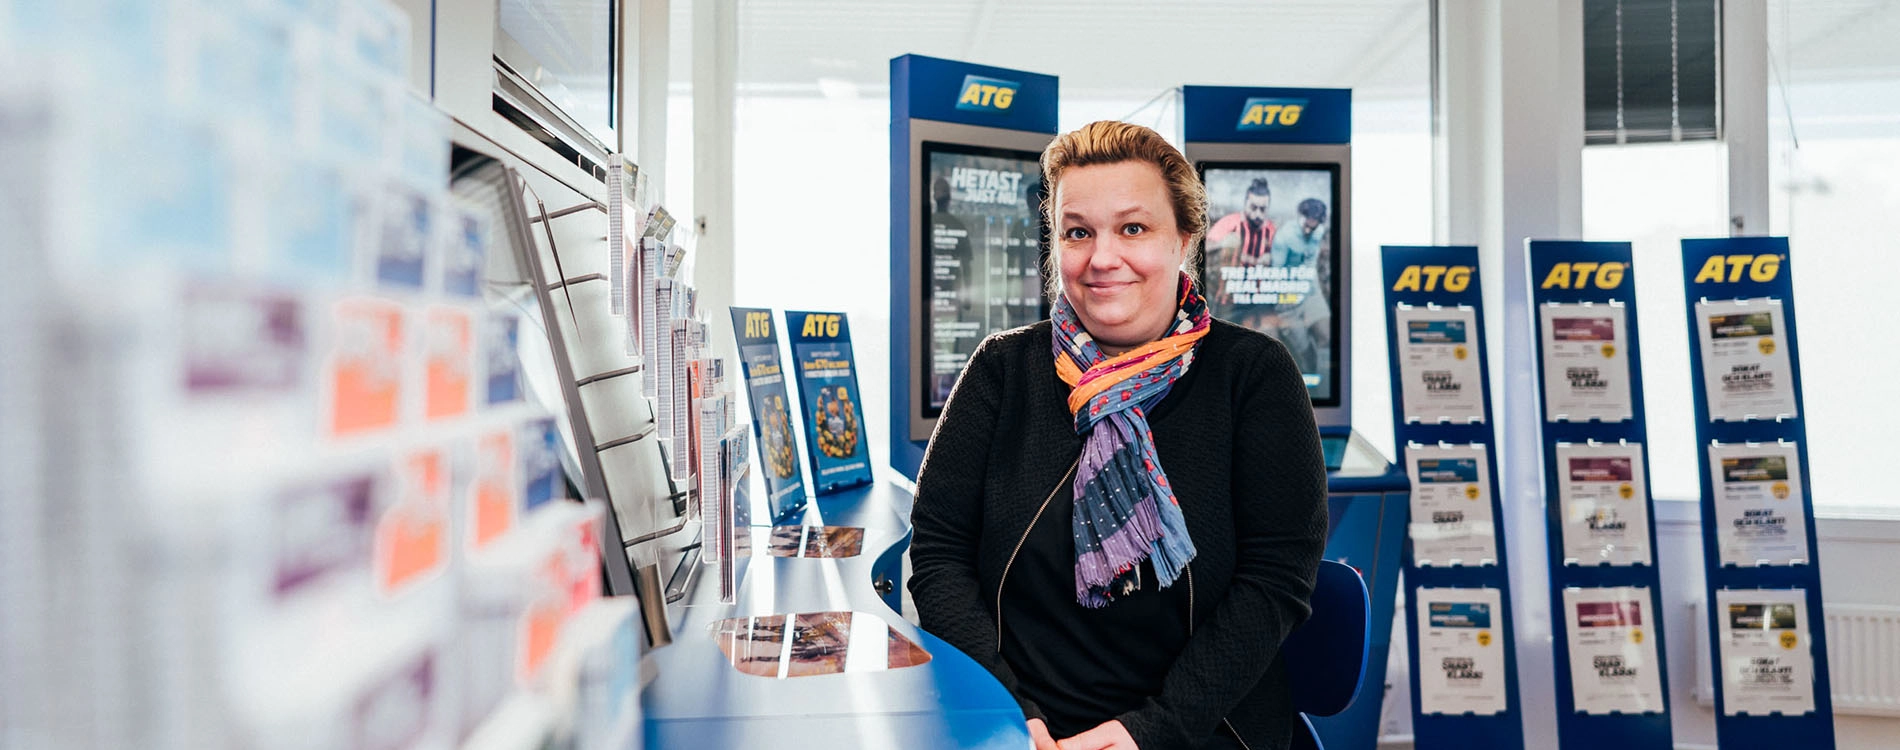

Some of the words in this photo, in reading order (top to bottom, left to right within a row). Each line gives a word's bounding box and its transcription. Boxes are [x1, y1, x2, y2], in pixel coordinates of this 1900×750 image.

[961, 83, 1014, 109] ATG
[1241, 105, 1302, 126] ATG
[951, 167, 1022, 192] HETAST
[965, 189, 997, 203] JUST
[1221, 266, 1245, 280] TRE
[1393, 265, 1471, 292] ATG
[1541, 262, 1625, 289] ATG
[1694, 254, 1780, 282] ATG
[1225, 280, 1257, 294] REAL
[745, 312, 769, 338] ATG
[802, 314, 839, 337] ATG
